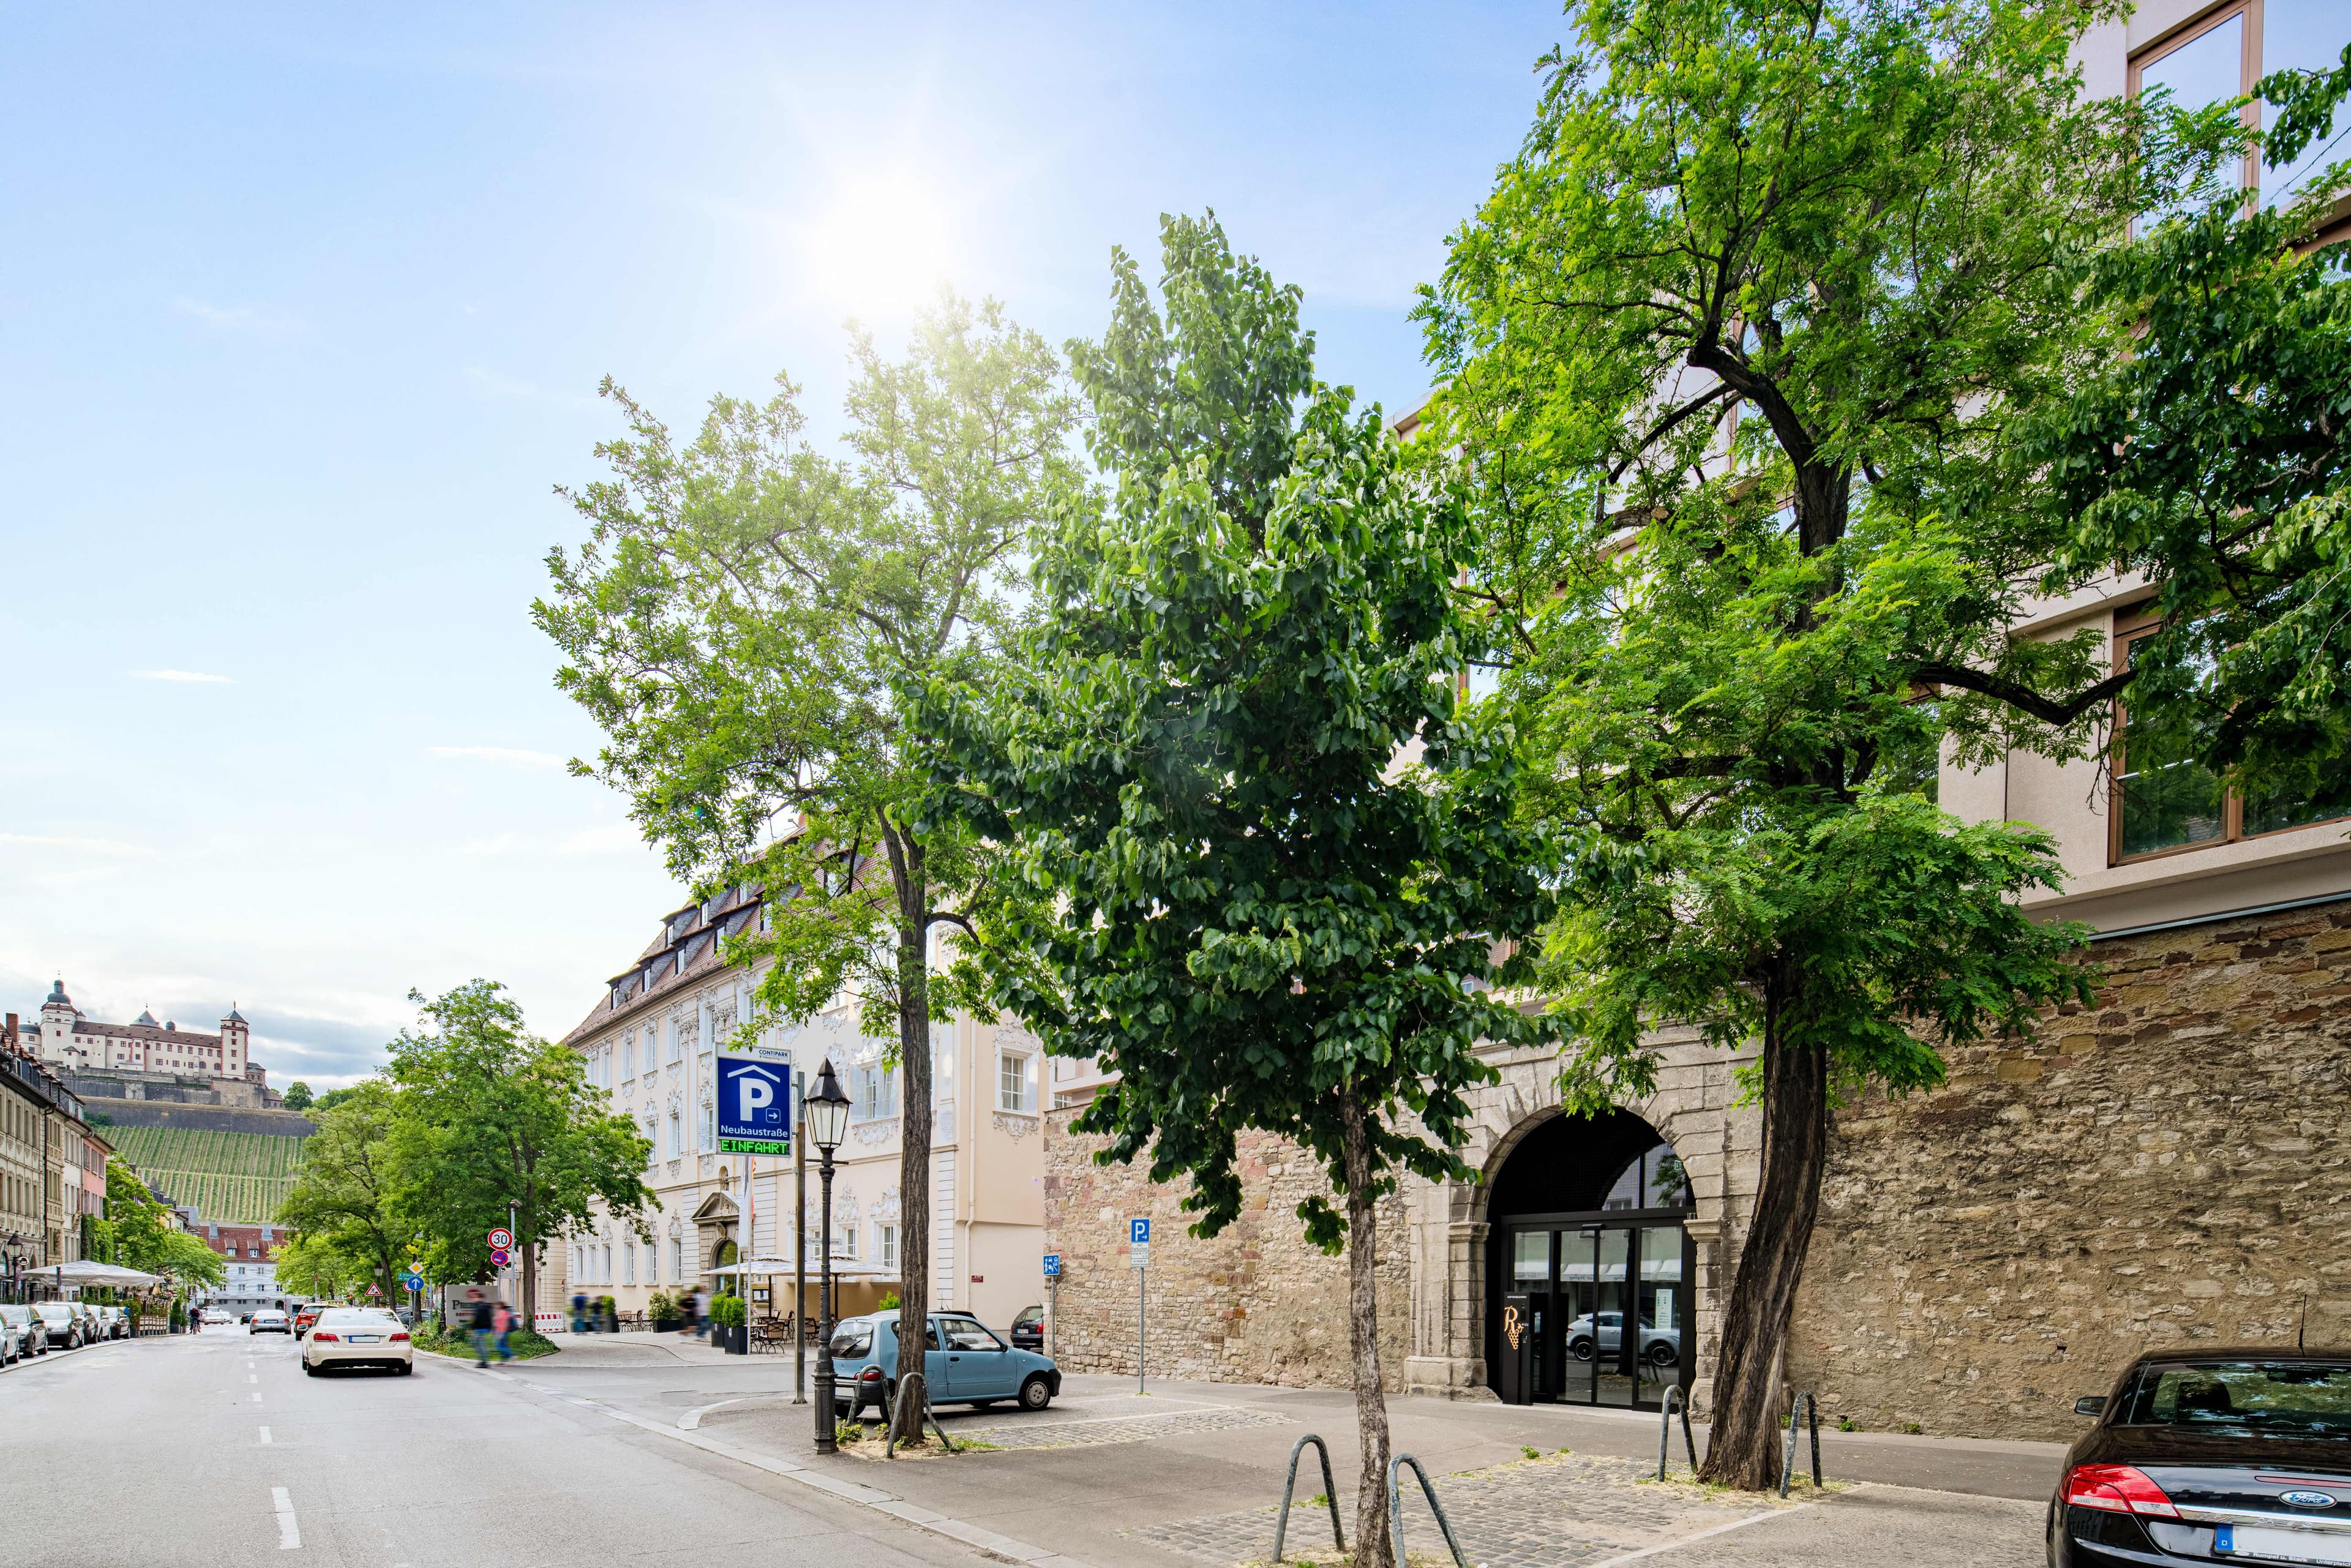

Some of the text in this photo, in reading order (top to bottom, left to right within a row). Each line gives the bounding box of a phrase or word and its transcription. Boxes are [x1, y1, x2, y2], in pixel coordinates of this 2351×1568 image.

[740, 1077, 773, 1122] P
[721, 1125, 788, 1138] Neubaustraße
[721, 1140, 787, 1153] EINFAHRT
[1135, 1222, 1146, 1241] P
[493, 1234, 508, 1244] 30
[2293, 1493, 2322, 1504] Ford
